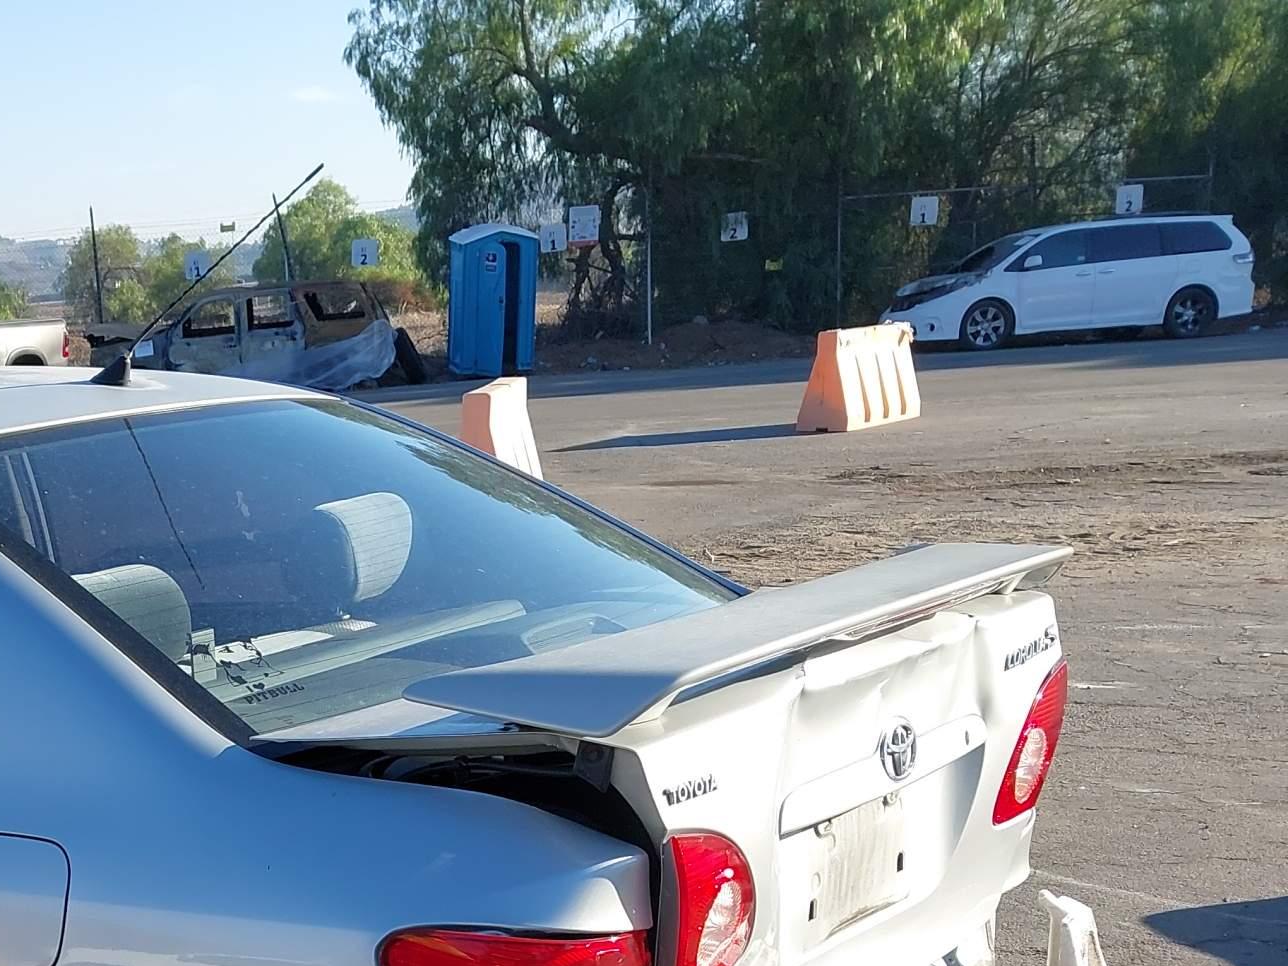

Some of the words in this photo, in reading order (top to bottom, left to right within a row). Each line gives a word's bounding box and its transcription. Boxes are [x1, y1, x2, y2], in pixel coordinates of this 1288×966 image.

[729, 228, 738, 240] 2
[360, 254, 368, 265] 2
[244, 682, 305, 704] PITBULL
[662, 773, 718, 806] TOYOTA
